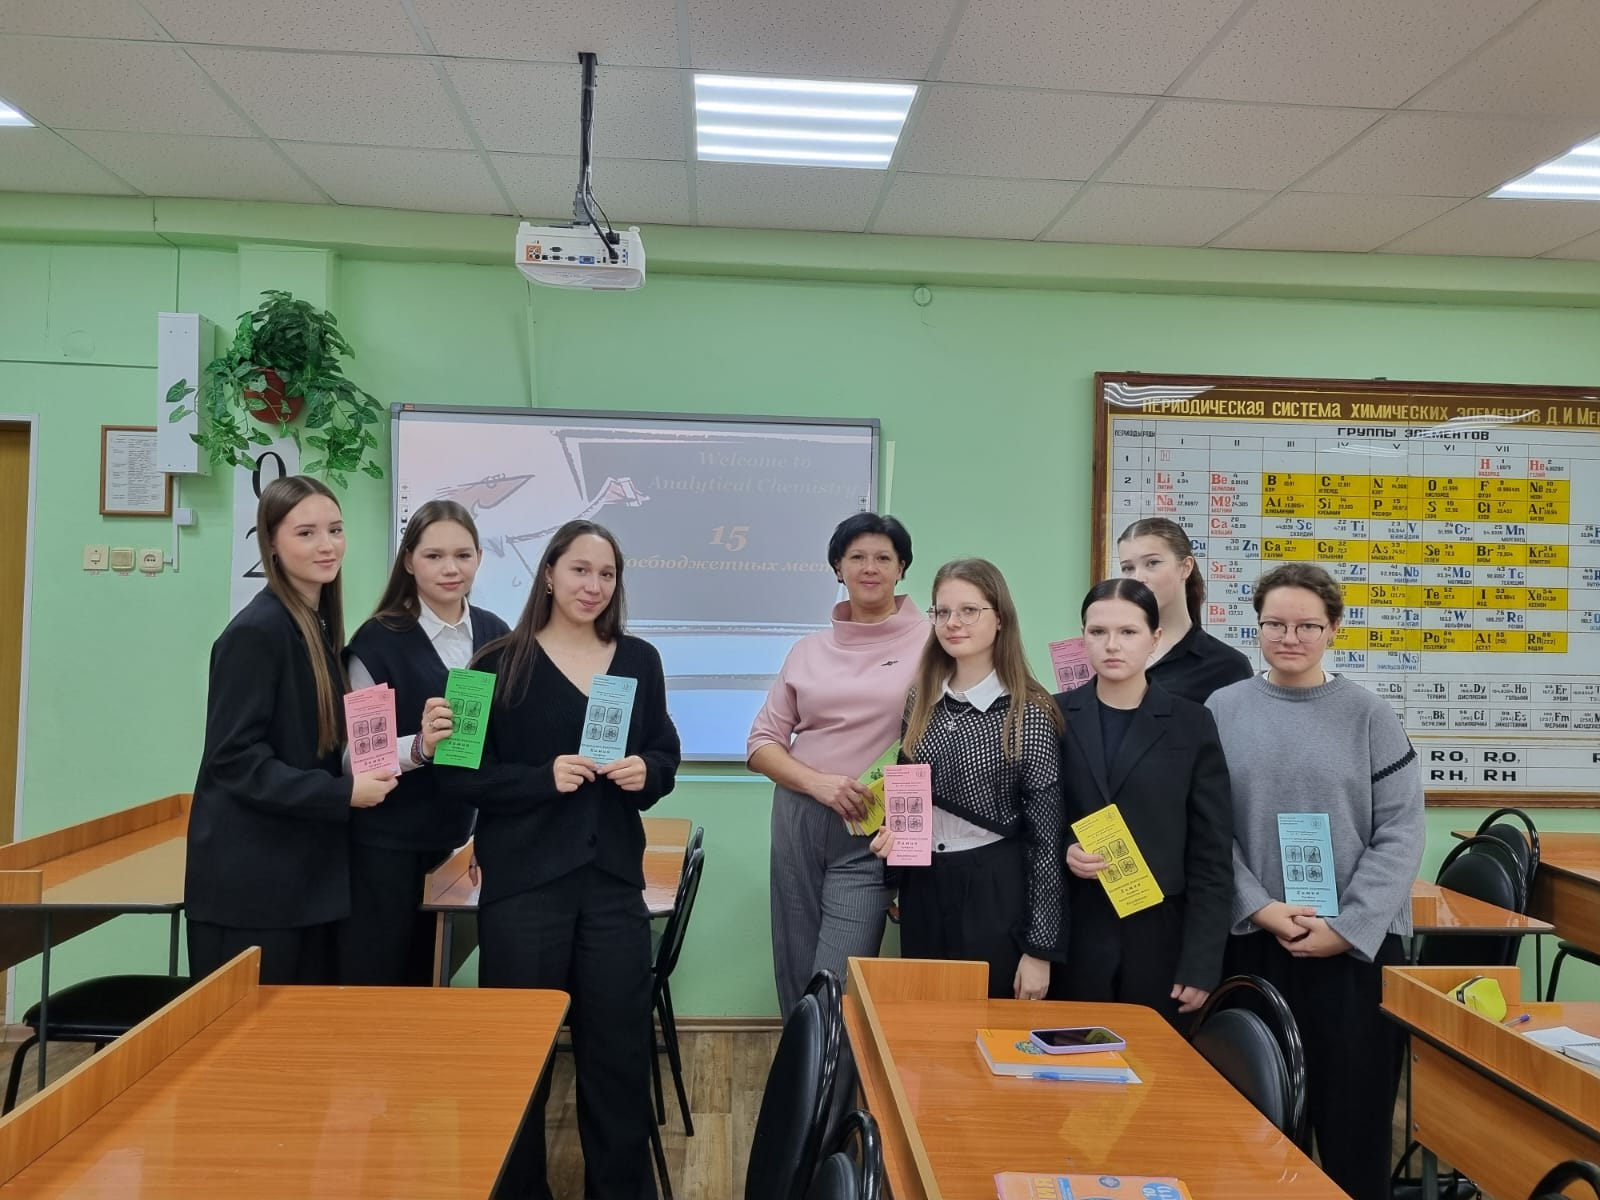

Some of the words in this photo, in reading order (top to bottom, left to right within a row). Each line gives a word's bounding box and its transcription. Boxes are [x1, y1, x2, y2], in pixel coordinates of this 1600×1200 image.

[1272, 401, 1341, 418] СИСТЕМА
[1350, 403, 1449, 421] ХИМИЧЕСКИХ
[1338, 428, 1396, 438] ГРУППЫ
[1404, 429, 1490, 441] ЭЛЕМЕНТОВ
[698, 451, 785, 469] Welcome
[791, 454, 812, 470] to
[1480, 458, 1490, 469] H
[1530, 460, 1545, 471] He
[1124, 476, 1132, 484] 2
[1157, 472, 1171, 484] Li
[1211, 473, 1228, 485] Be
[1267, 475, 1277, 486] B
[1322, 476, 1331, 487] C
[1374, 478, 1384, 489] N
[648, 475, 752, 494] Analytical
[756, 477, 859, 499] Chemistry
[1480, 480, 1489, 491] F
[1529, 482, 1543, 493] Ne
[1157, 494, 1174, 506] Na
[1211, 495, 1231, 507] Mg
[1266, 496, 1281, 508] Al
[1318, 497, 1331, 509] Si
[1373, 499, 1383, 510] P
[1427, 500, 1437, 513] S
[1478, 502, 1490, 514] Cl
[1529, 503, 1545, 515] Ar
[1211, 518, 1228, 529] Ca
[1296, 519, 1312, 531] Sc
[1351, 520, 1365, 532] Ti
[1408, 522, 1417, 534] V
[1455, 523, 1471, 535] Cr
[1506, 524, 1525, 536] Mn
[708, 525, 751, 552] 15
[1190, 539, 1206, 550] Cu
[1243, 540, 1259, 551] Zn
[1372, 543, 1388, 554] As
[1424, 544, 1441, 556] Se
[1477, 545, 1494, 557] Br
[1529, 546, 1544, 558] Kr
[1211, 560, 1227, 573] Sr
[1350, 564, 1366, 575] Zr
[1403, 566, 1419, 577] Nb
[1453, 567, 1471, 578] Mo
[1508, 568, 1524, 579] Tc
[1371, 586, 1386, 598] Sb
[1424, 588, 1440, 599] Te
[1528, 590, 1542, 601] Xe
[1210, 605, 1226, 616] Ba
[1350, 607, 1365, 619] Hf
[1403, 609, 1420, 621] Ta
[1453, 610, 1467, 621] W
[1507, 611, 1524, 623] Re
[1241, 627, 1258, 639] Hg
[1370, 630, 1384, 642] Bi
[1423, 631, 1440, 643] Po
[1528, 633, 1542, 645] Rn
[1349, 651, 1365, 663] Ku
[1433, 683, 1445, 693] Tb
[1473, 683, 1486, 694] Dy
[1515, 684, 1527, 694] Ho
[1555, 684, 1568, 695] Er
[1433, 710, 1445, 720] Bk
[1514, 711, 1527, 722] Es
[1554, 711, 1570, 722] Fm
